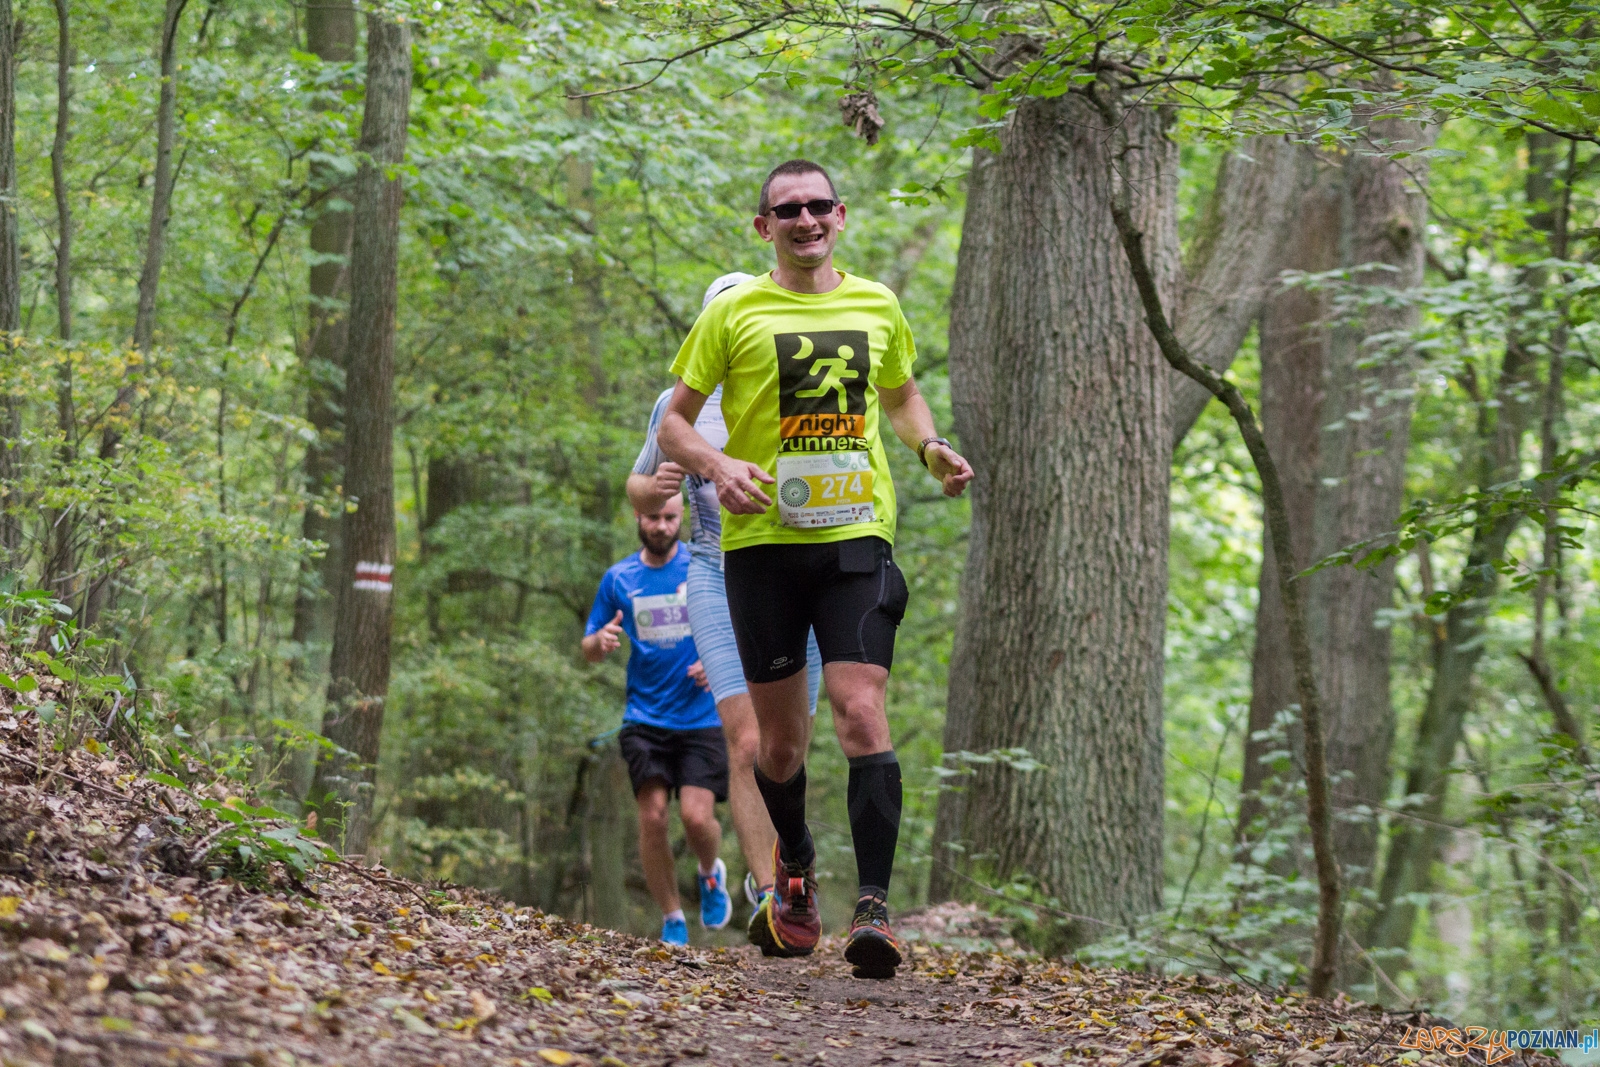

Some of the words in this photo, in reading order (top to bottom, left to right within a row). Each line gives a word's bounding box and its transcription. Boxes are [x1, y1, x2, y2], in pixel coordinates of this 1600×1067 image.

[799, 414, 856, 436] night
[821, 473, 863, 499] 274
[663, 607, 682, 623] 35
